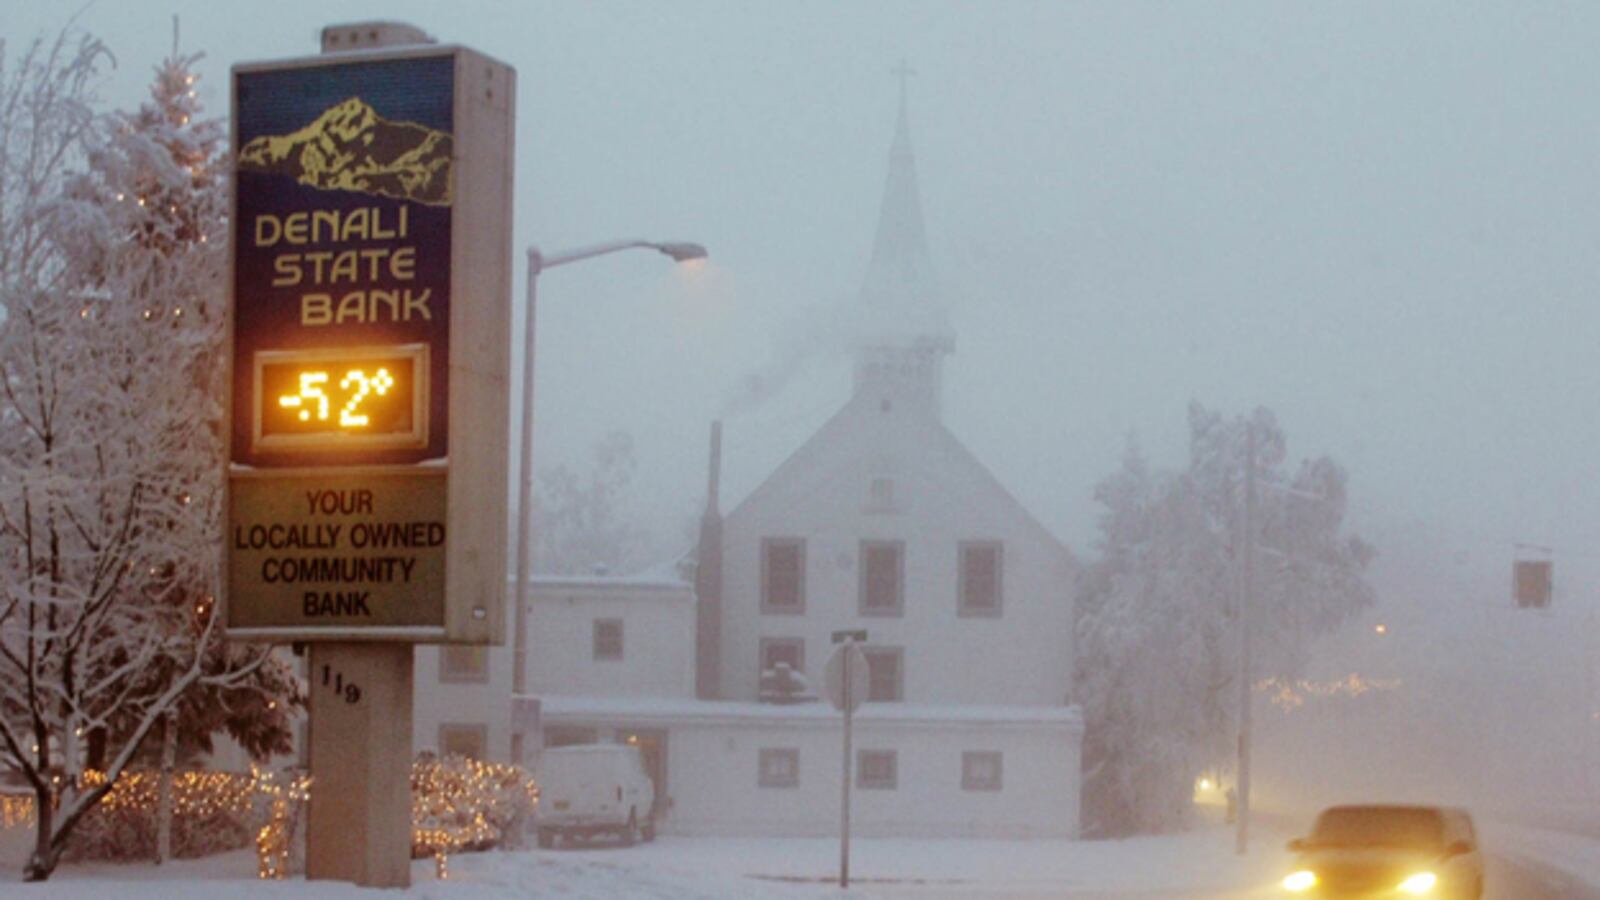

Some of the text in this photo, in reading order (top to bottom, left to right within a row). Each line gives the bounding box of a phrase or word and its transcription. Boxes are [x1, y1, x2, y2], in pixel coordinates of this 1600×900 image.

[255, 205, 408, 247] DENALI
[271, 247, 416, 287] STATE
[301, 288, 432, 326] BANK
[306, 490, 373, 515] YOUR
[235, 522, 446, 550] LOCALLY OWNED
[262, 556, 417, 583] COMMUNITY
[303, 592, 370, 617] BANK
[322, 665, 361, 703] 119
